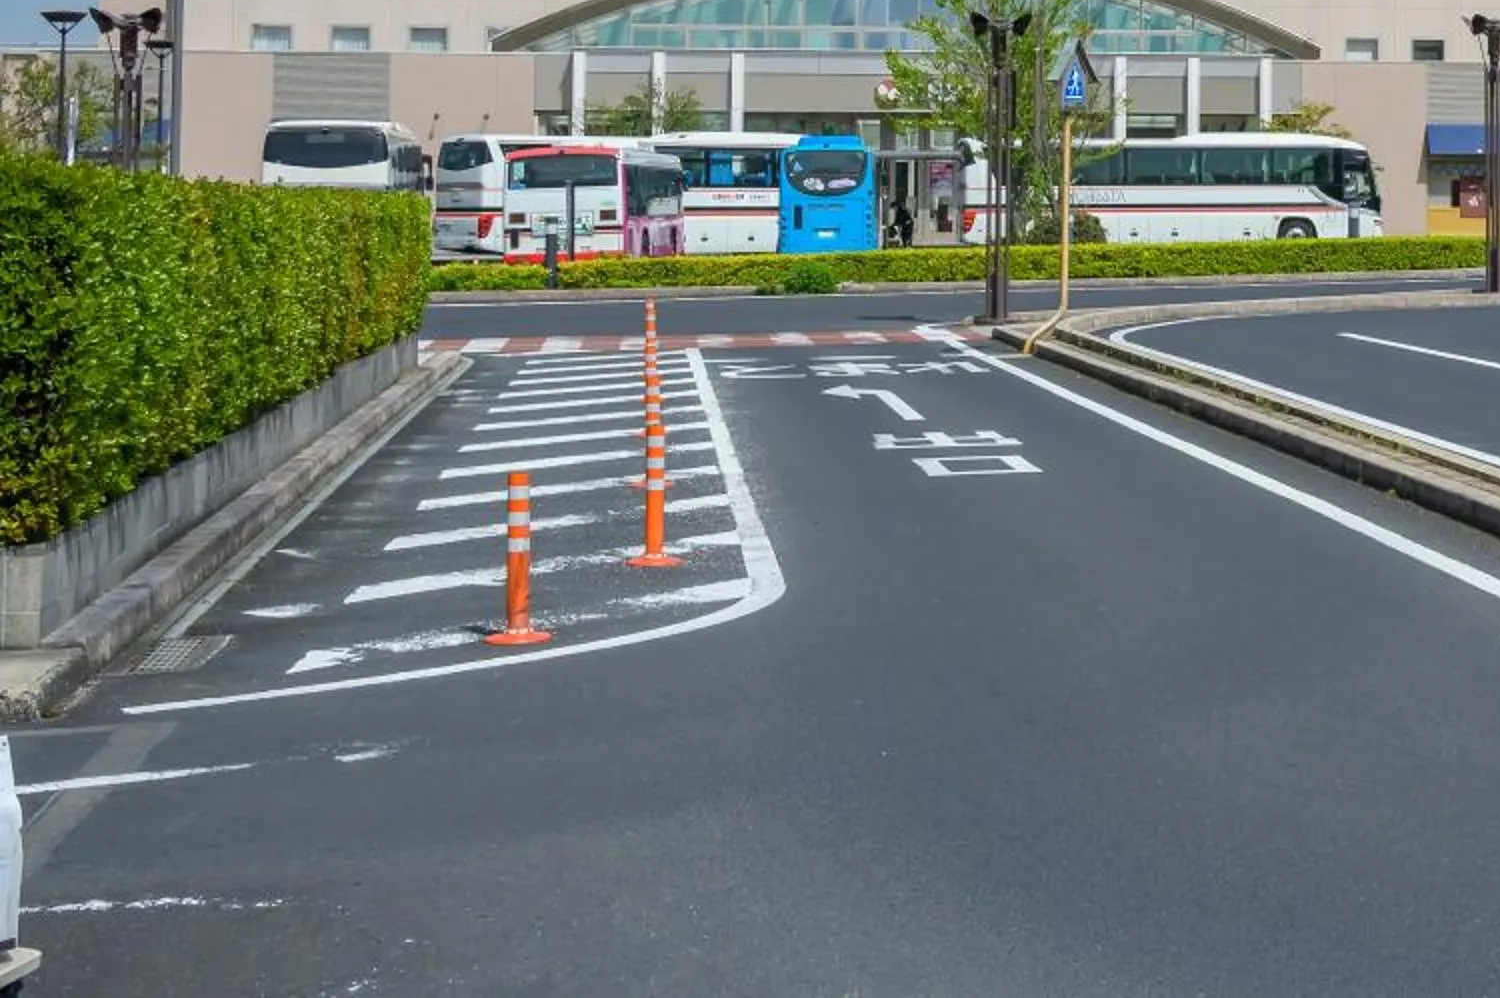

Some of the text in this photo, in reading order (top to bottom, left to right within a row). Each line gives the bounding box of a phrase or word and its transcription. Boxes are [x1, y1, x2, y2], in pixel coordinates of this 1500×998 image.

[721, 361, 990, 378] とまれ
[872, 429, 1044, 477] 出口
